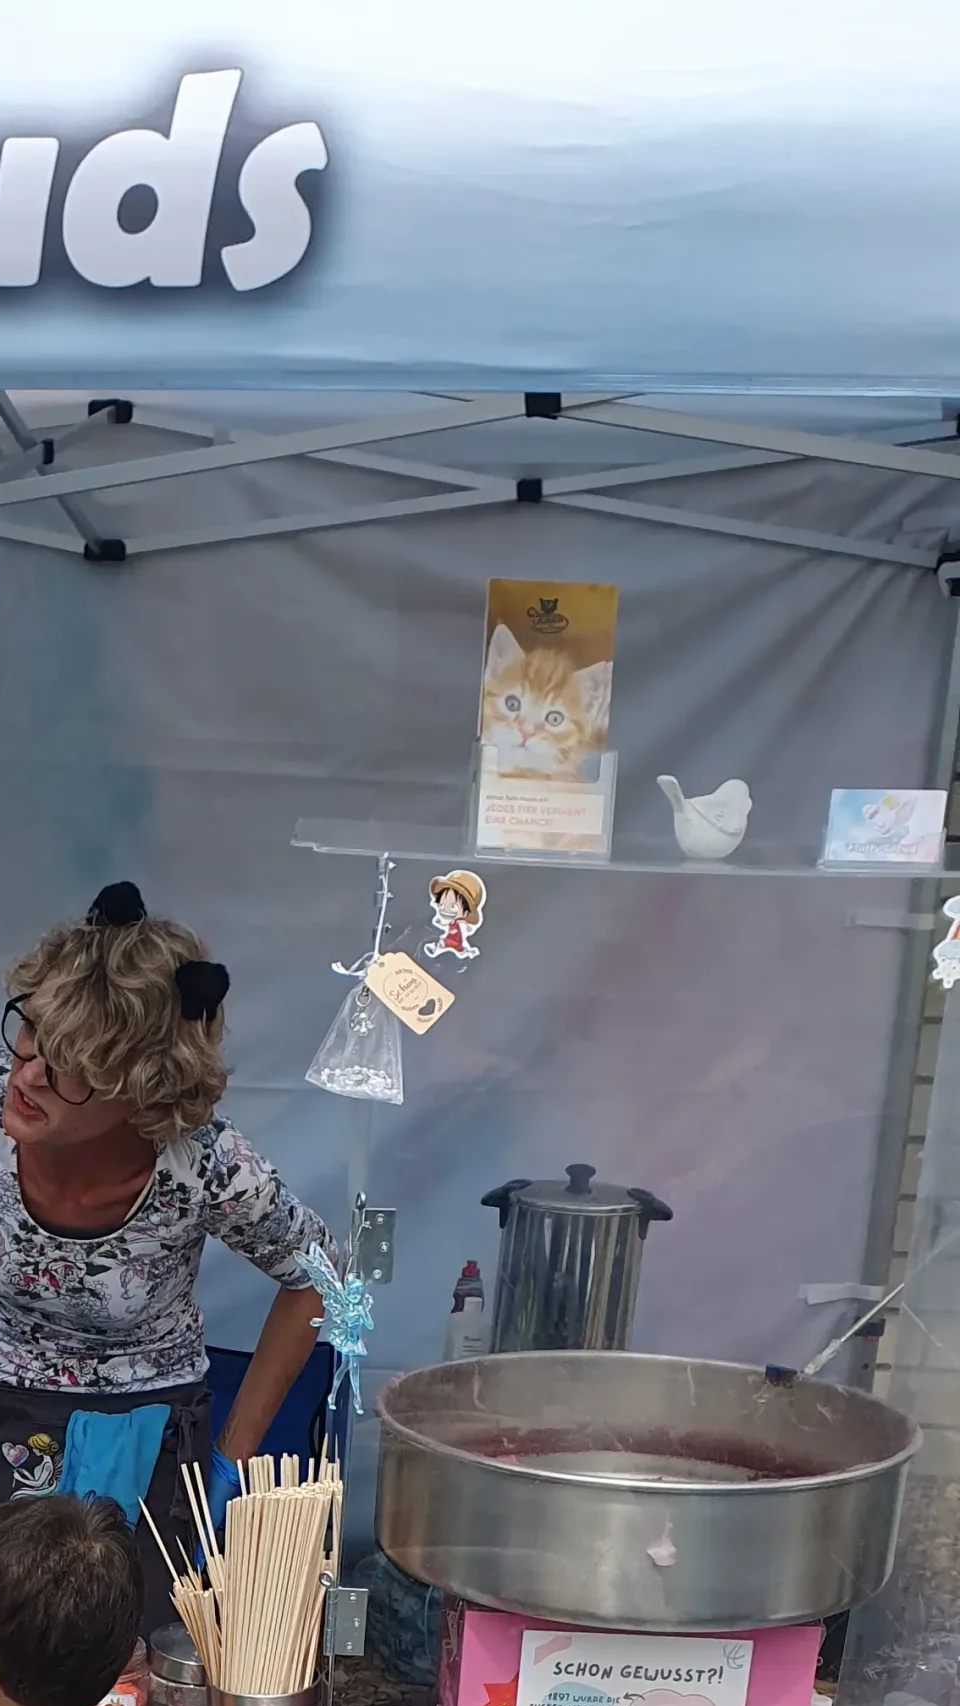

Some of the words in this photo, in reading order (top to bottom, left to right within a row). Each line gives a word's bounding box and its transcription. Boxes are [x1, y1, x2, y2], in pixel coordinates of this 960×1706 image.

[553, 1661, 614, 1680] SCHON
[620, 1664, 724, 1685] GEWUSST?!
[547, 1692, 570, 1701] 1897
[572, 1693, 604, 1704] WURDE
[607, 1695, 621, 1704] DIE
